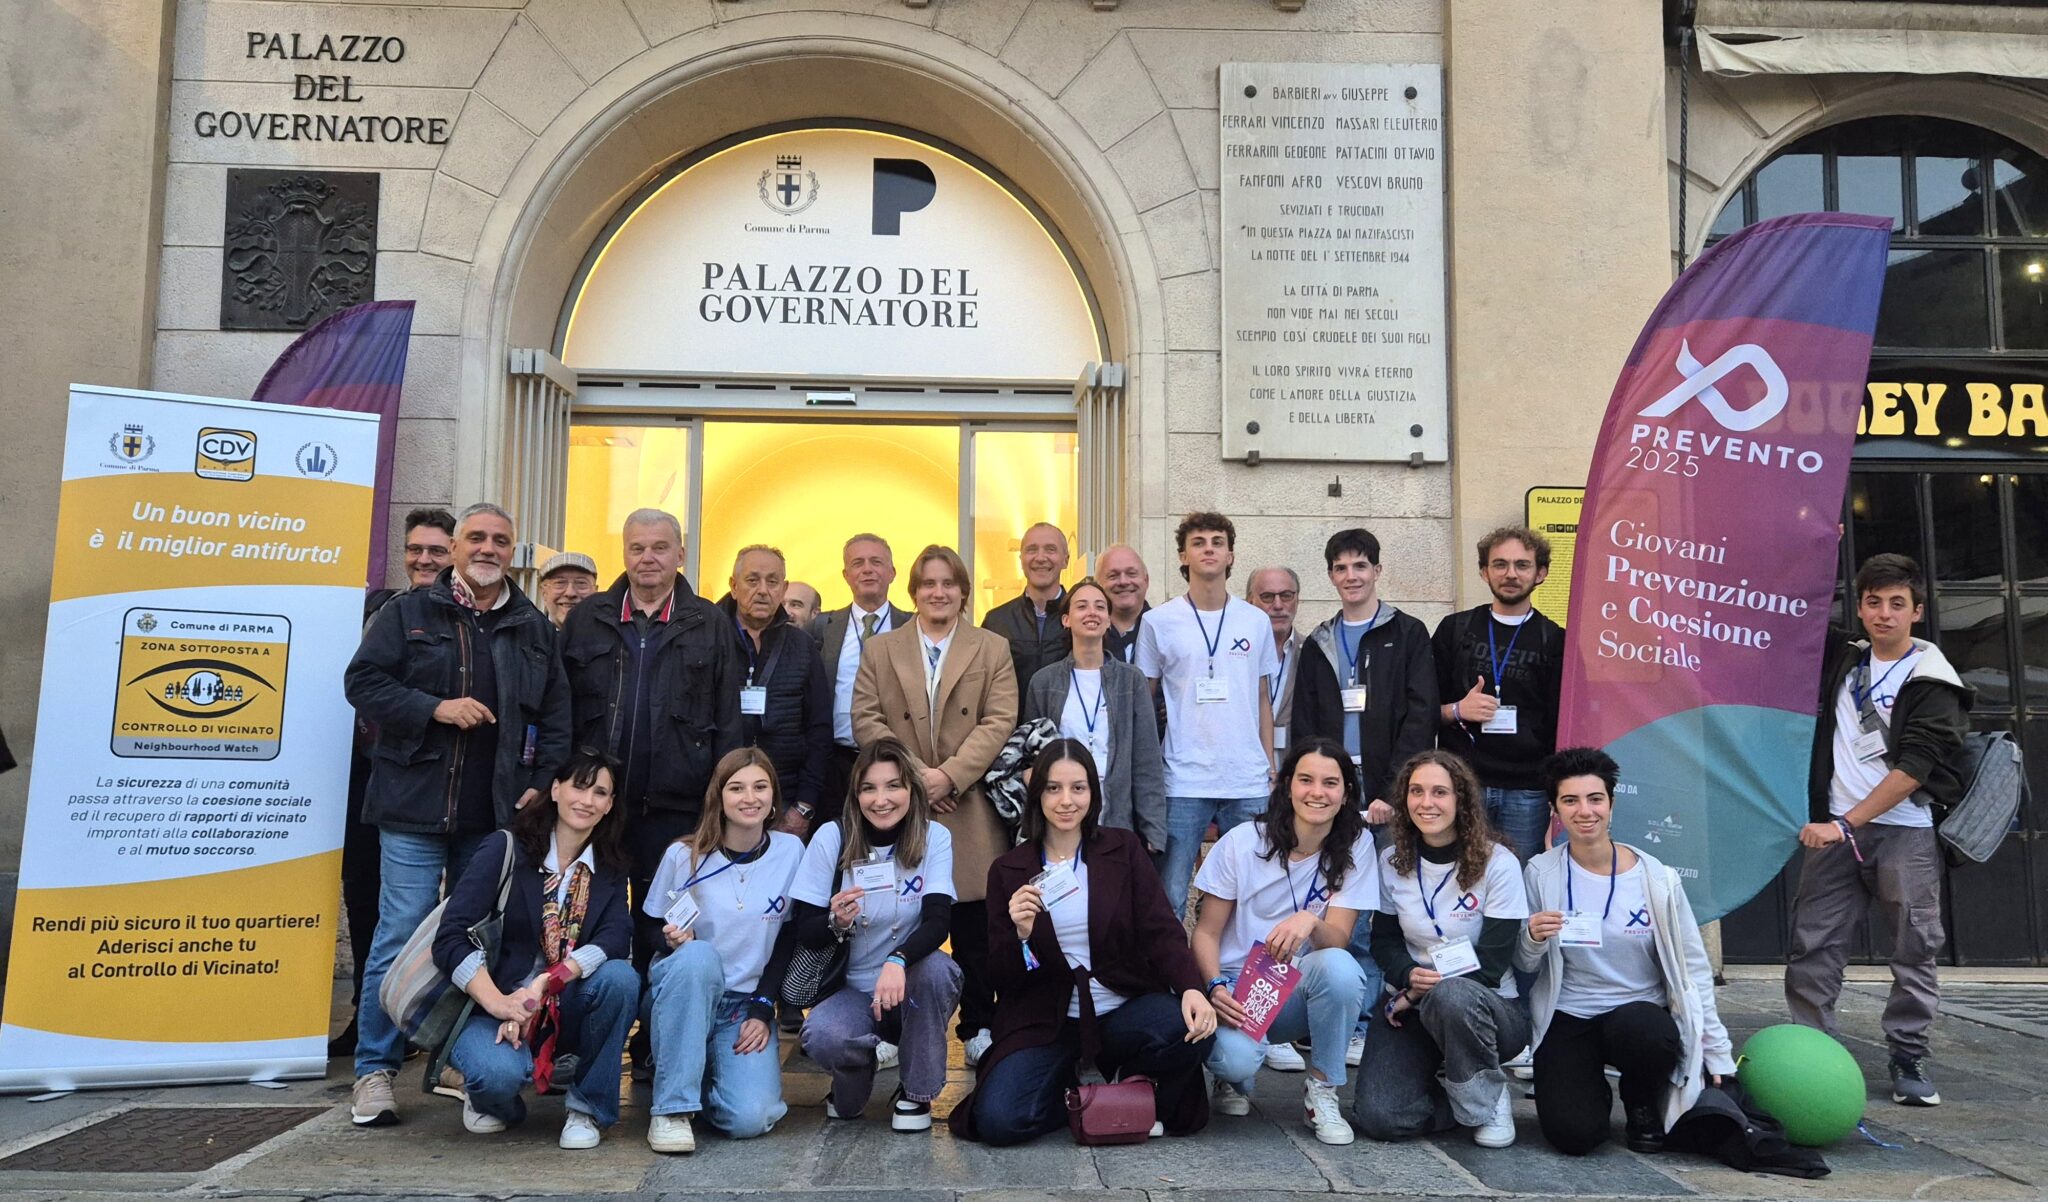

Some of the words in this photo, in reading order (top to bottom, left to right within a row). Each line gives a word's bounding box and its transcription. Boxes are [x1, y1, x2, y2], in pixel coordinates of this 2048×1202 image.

[246, 31, 405, 63] PALAZZO
[293, 74, 363, 103] DEL
[1273, 87, 1321, 100] BARBIERI
[1342, 88, 1388, 101] GIUSEPPE
[194, 111, 449, 144] GOVERNATORE
[1222, 115, 1266, 128] FERRARI
[1272, 116, 1325, 129] VINCENZO
[1336, 117, 1379, 130] MASSARI
[1384, 118, 1438, 131] ELEUTERIO
[1227, 145, 1278, 158] FERRARINI
[1285, 146, 1327, 159] GEDEONE
[1336, 147, 1387, 160] PATTACINI
[1394, 148, 1435, 160] OTTAVIO
[1240, 174, 1284, 188] FANFONI
[1292, 176, 1322, 188] AFRO
[1336, 176, 1381, 189] VESCOVI
[1387, 177, 1423, 190] BRUNO
[1280, 204, 1322, 215] SEVIZIATI
[1328, 205, 1332, 215] E
[1339, 205, 1384, 216] TRUCIDATI
[744, 223, 784, 232] Comune
[787, 224, 795, 233] di
[799, 224, 830, 234] Parma
[1261, 227, 1293, 238] QUESTA
[1299, 228, 1331, 239] PIAZZA
[1337, 228, 1350, 239] DAI
[1355, 228, 1414, 240] NAZIFASCISTI
[1252, 250, 1262, 260] LA
[1267, 250, 1295, 261] NOTTE
[1301, 250, 1317, 261] DEL
[1335, 251, 1386, 262] SETTEMBRE
[1390, 252, 1409, 263] 1944
[702, 262, 883, 295] PALAZZO
[898, 267, 978, 297] DEL
[1284, 285, 1296, 296] LA
[1333, 286, 1342, 297] DI
[1347, 286, 1379, 298] PARMA
[700, 294, 978, 328] GOVERNATORE
[1267, 308, 1285, 319] NON
[1291, 308, 1313, 319] VIDE
[1319, 308, 1338, 319] MAI
[1345, 309, 1359, 320] NEI
[1366, 309, 1398, 320] SECOLI
[1237, 330, 1276, 342] SCEMPIO
[1313, 331, 1357, 343] CRUDELE
[1362, 332, 1376, 343] DEI
[1382, 332, 1403, 344] SUOI
[1408, 333, 1430, 344] FIGLI
[1253, 365, 1260, 376] IL
[1265, 366, 1289, 377] LORO
[1296, 366, 1331, 377] SPIRITO
[1375, 367, 1412, 379] ETERNO
[1250, 388, 1275, 400] COME
[1329, 389, 1360, 401] DELLA
[1367, 390, 1416, 402] GIUSTIZIA
[1289, 412, 1294, 423] E
[1299, 412, 1330, 423] DELLA
[203, 439, 251, 456] CDV
[1630, 423, 1823, 474] PREVENTO
[1625, 446, 1699, 477] 2025
[132, 501, 164, 522] Un
[171, 505, 230, 527] buon
[238, 510, 306, 532] vicino
[89, 529, 105, 549] è
[117, 531, 132, 550] il
[139, 534, 226, 557] miglior
[231, 542, 341, 564] antifurto!
[1610, 519, 1727, 565] Giovani
[1605, 555, 1808, 618] Prevenzione
[171, 621, 215, 631] Comune
[219, 623, 229, 631] di
[233, 624, 274, 633] PARMA
[1602, 601, 1618, 619] e
[1628, 596, 1772, 650] Coesione
[141, 642, 175, 651] ZONA
[180, 644, 258, 655] SOTTOPOSTA
[1597, 629, 1702, 672] Sociale
[122, 722, 197, 732] CONTROLLO
[202, 724, 213, 733] DI
[218, 725, 274, 734] VICINATO
[134, 742, 220, 752] Neighbourhood
[224, 744, 258, 753] Watch
[96, 776, 113, 788] La
[117, 777, 182, 789] sicurezza
[186, 778, 197, 789] di
[201, 780, 225, 789] una
[229, 778, 290, 790] comunità
[68, 793, 109, 806] passa
[113, 794, 183, 806] attraverso
[187, 795, 199, 806] la
[202, 796, 262, 806] coesione
[265, 797, 311, 807] sociale
[70, 810, 88, 821] ed
[91, 811, 100, 821] il
[103, 813, 165, 823] recupero
[169, 812, 181, 822] di
[184, 812, 237, 824] rapporti
[241, 812, 253, 823] di
[257, 813, 306, 823] vicinato
[87, 828, 160, 840] improntati
[162, 828, 187, 839] alla
[191, 828, 289, 840] collaborazione
[118, 847, 126, 855] e
[129, 845, 142, 855] al
[146, 846, 190, 855] mutuo
[193, 847, 257, 855] soccorso.
[32, 917, 86, 932] Rendi
[91, 915, 119, 934] più
[124, 915, 180, 931] sicuro
[185, 915, 196, 930] il
[202, 916, 230, 929] tuo
[235, 914, 320, 932] quartiere!
[97, 939, 174, 955] Aderisci
[178, 938, 233, 953] anche
[238, 939, 256, 952] tu
[68, 964, 85, 979] al
[91, 961, 176, 978] Controllo
[182, 961, 197, 976] di
[203, 960, 279, 975] Vicinato!
[1256, 978, 1279, 999] ORA
